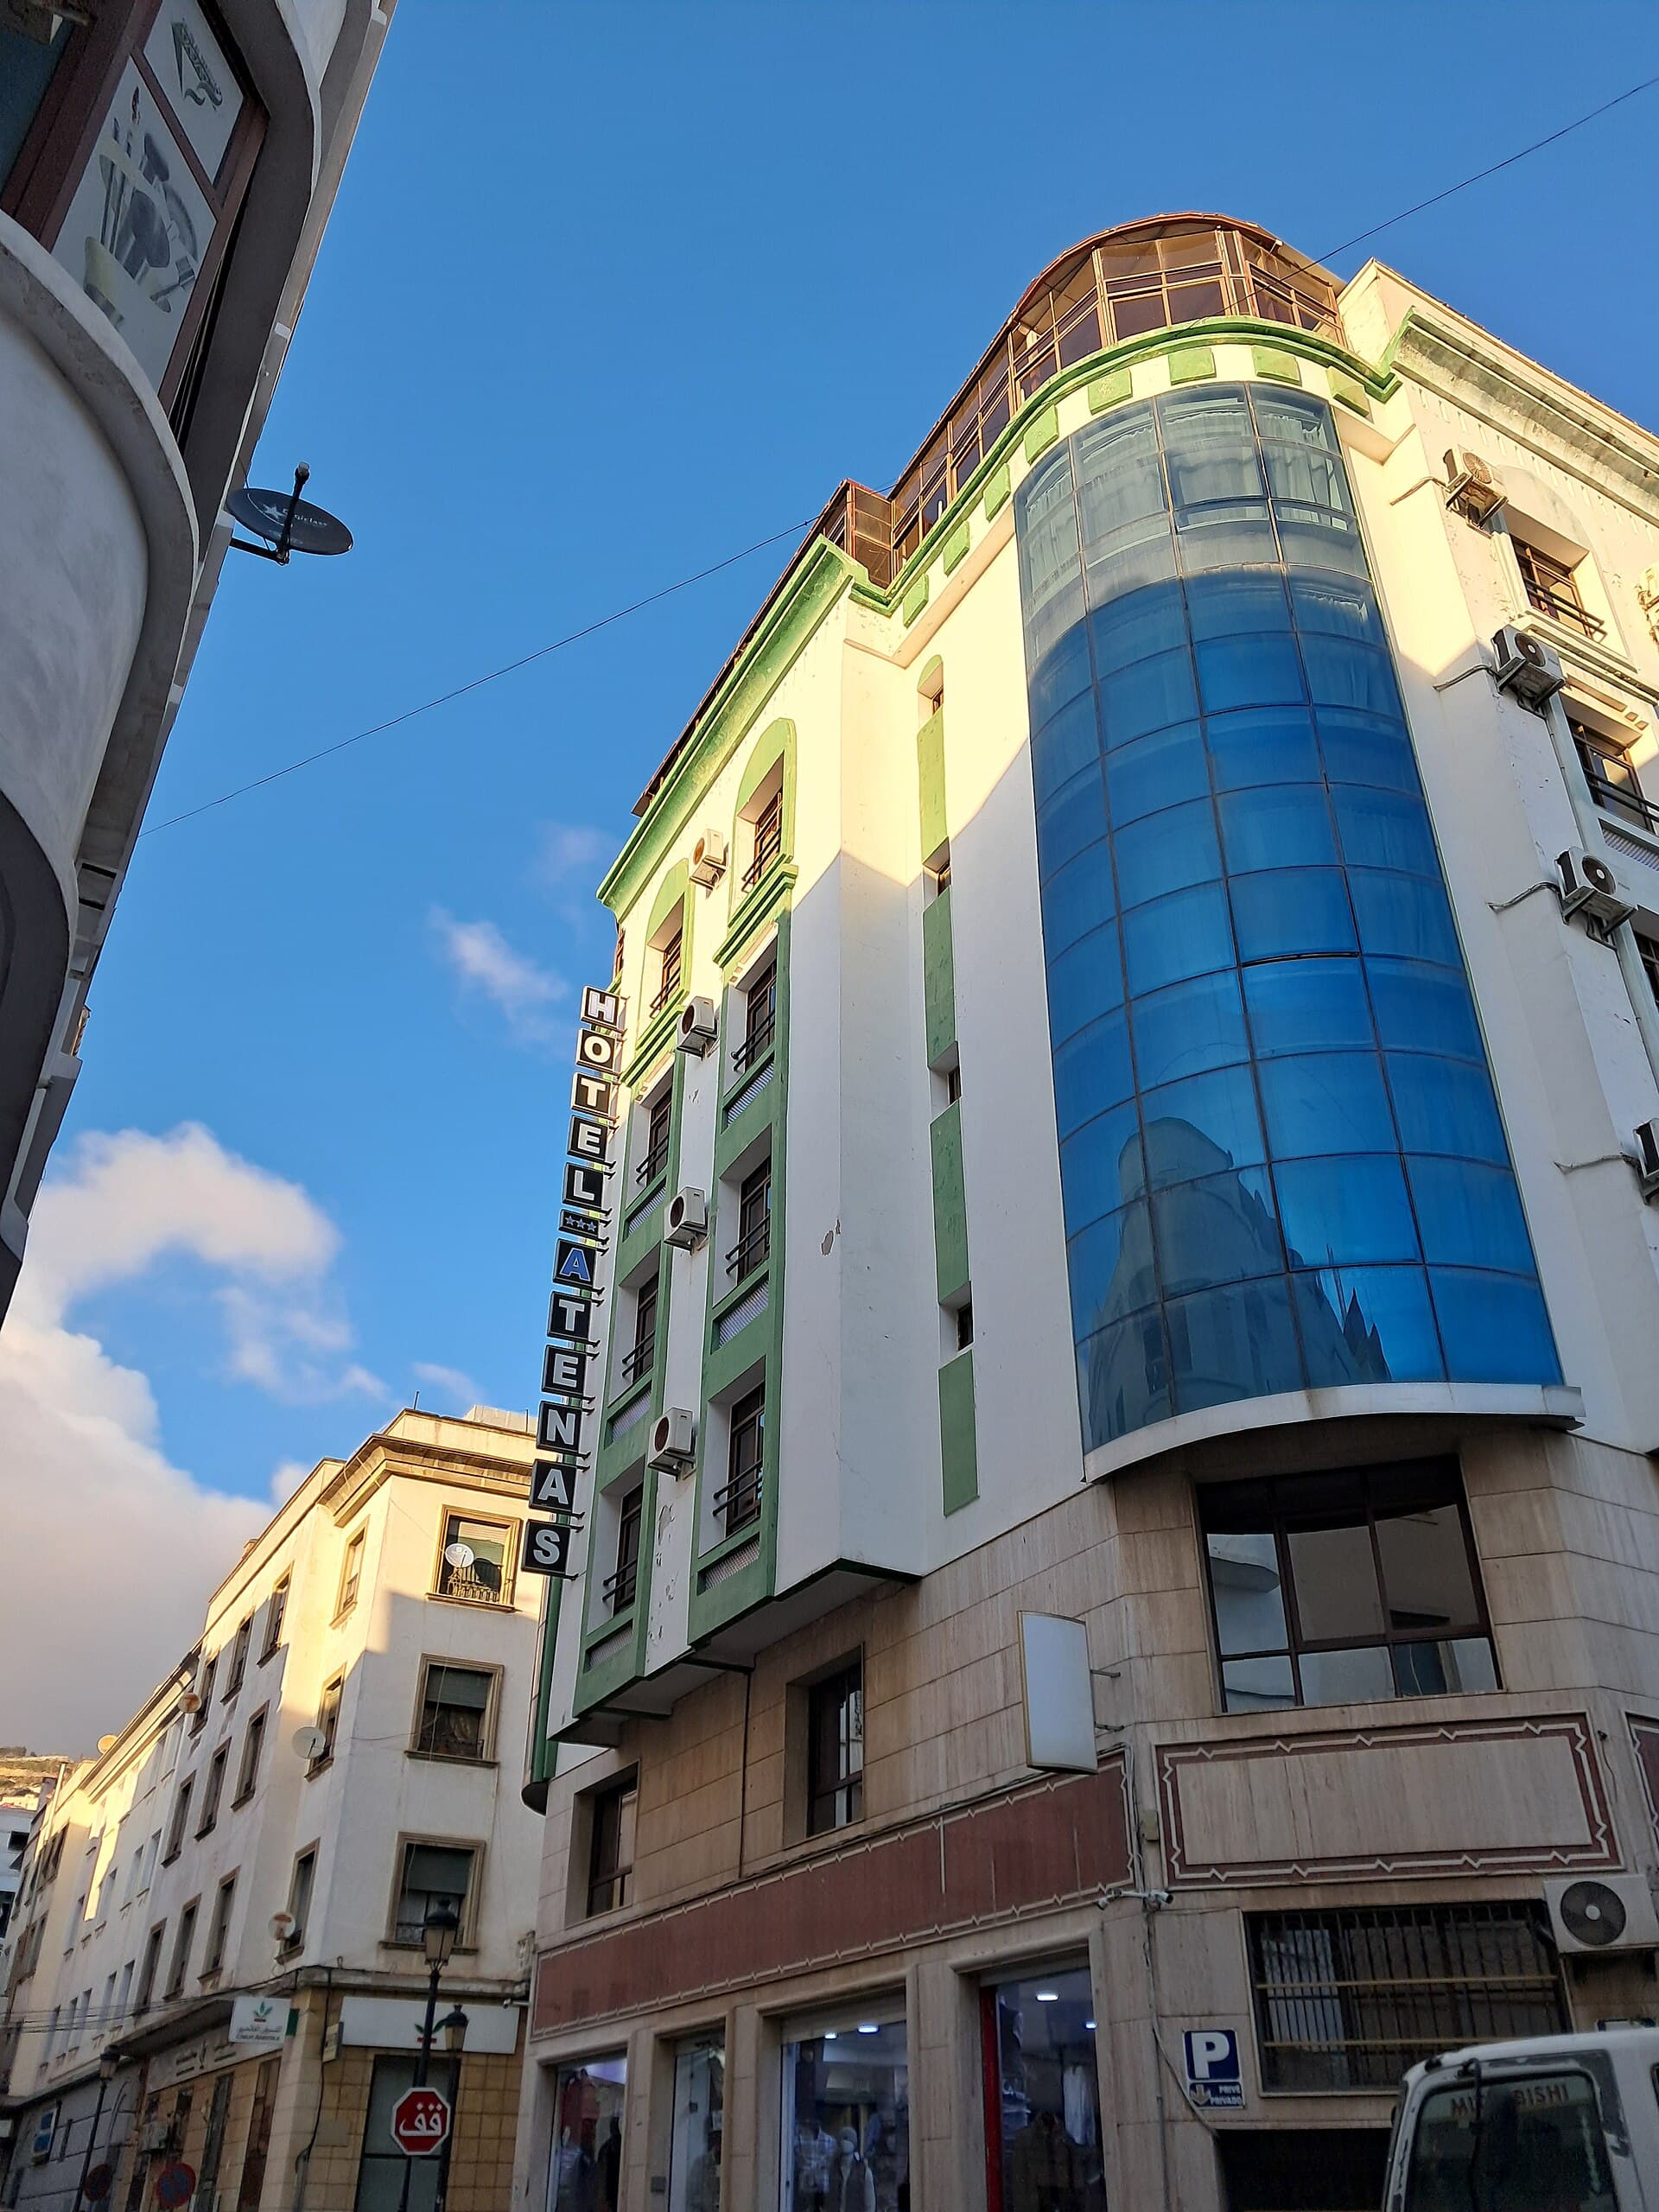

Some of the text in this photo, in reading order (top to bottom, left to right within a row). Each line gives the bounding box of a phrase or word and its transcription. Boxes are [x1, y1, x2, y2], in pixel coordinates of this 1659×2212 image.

[533, 992, 615, 1565] HOTEL ATENAS
[1191, 2031, 1230, 2079] P
[399, 2102, 442, 2137] قف
